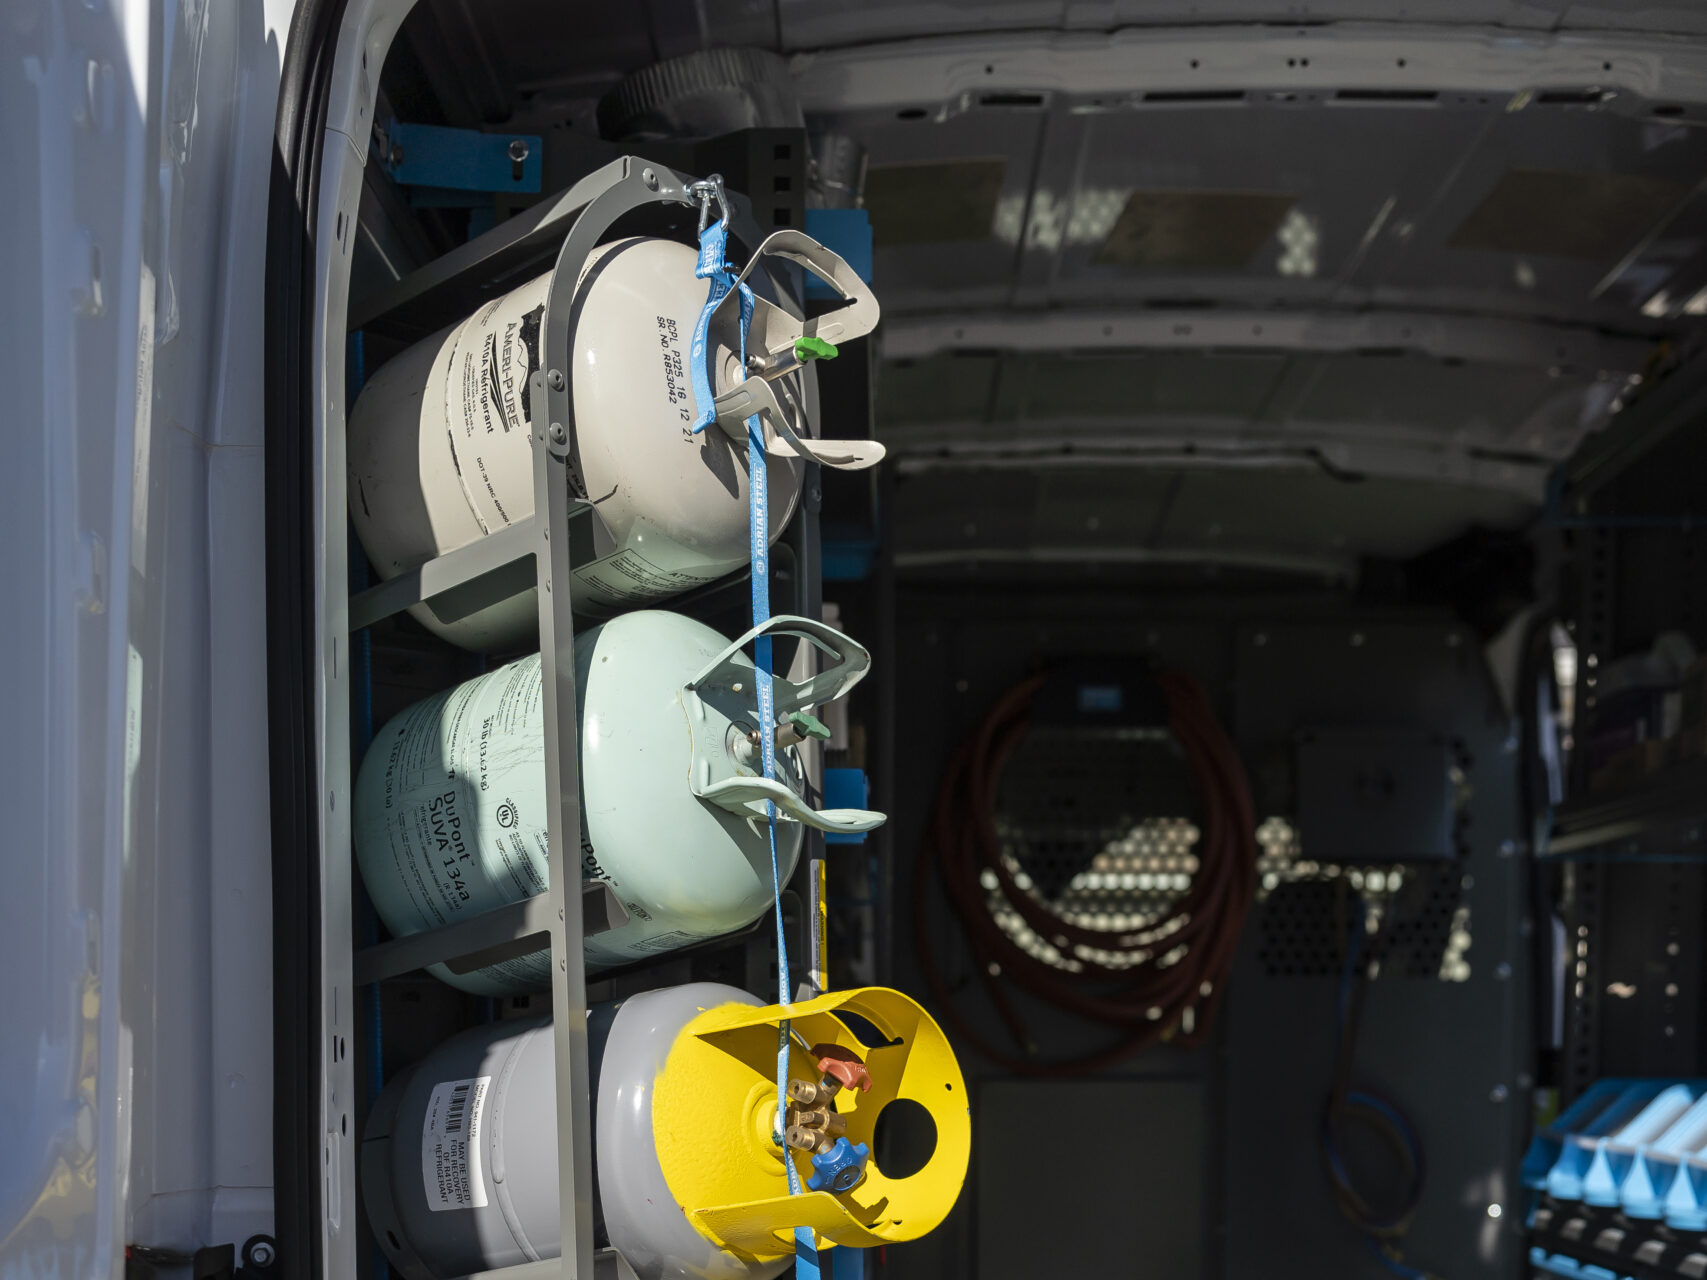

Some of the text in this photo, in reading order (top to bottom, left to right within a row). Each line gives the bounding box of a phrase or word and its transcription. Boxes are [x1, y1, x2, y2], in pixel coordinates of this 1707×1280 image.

[479, 333, 494, 434] R410A Refrigerant
[662, 353, 677, 404] R853042
[665, 317, 694, 443] BCPL P325 16 12 21
[485, 482, 496, 499] NRC
[754, 466, 764, 557] ADRIAN STEEL
[481, 716, 490, 729] 30
[762, 684, 772, 772] ADRIAN STEEL
[442, 790, 471, 861] DuPont
[500, 808, 509, 824] UL
[442, 856, 471, 901] 134a
[435, 1143, 448, 1202] REFRIGERANT
[443, 1151, 453, 1193] OF R410A
[449, 1139, 464, 1204] FOR RECOVERY
[458, 1163, 466, 1174] BE
[460, 1177, 470, 1200] USED
